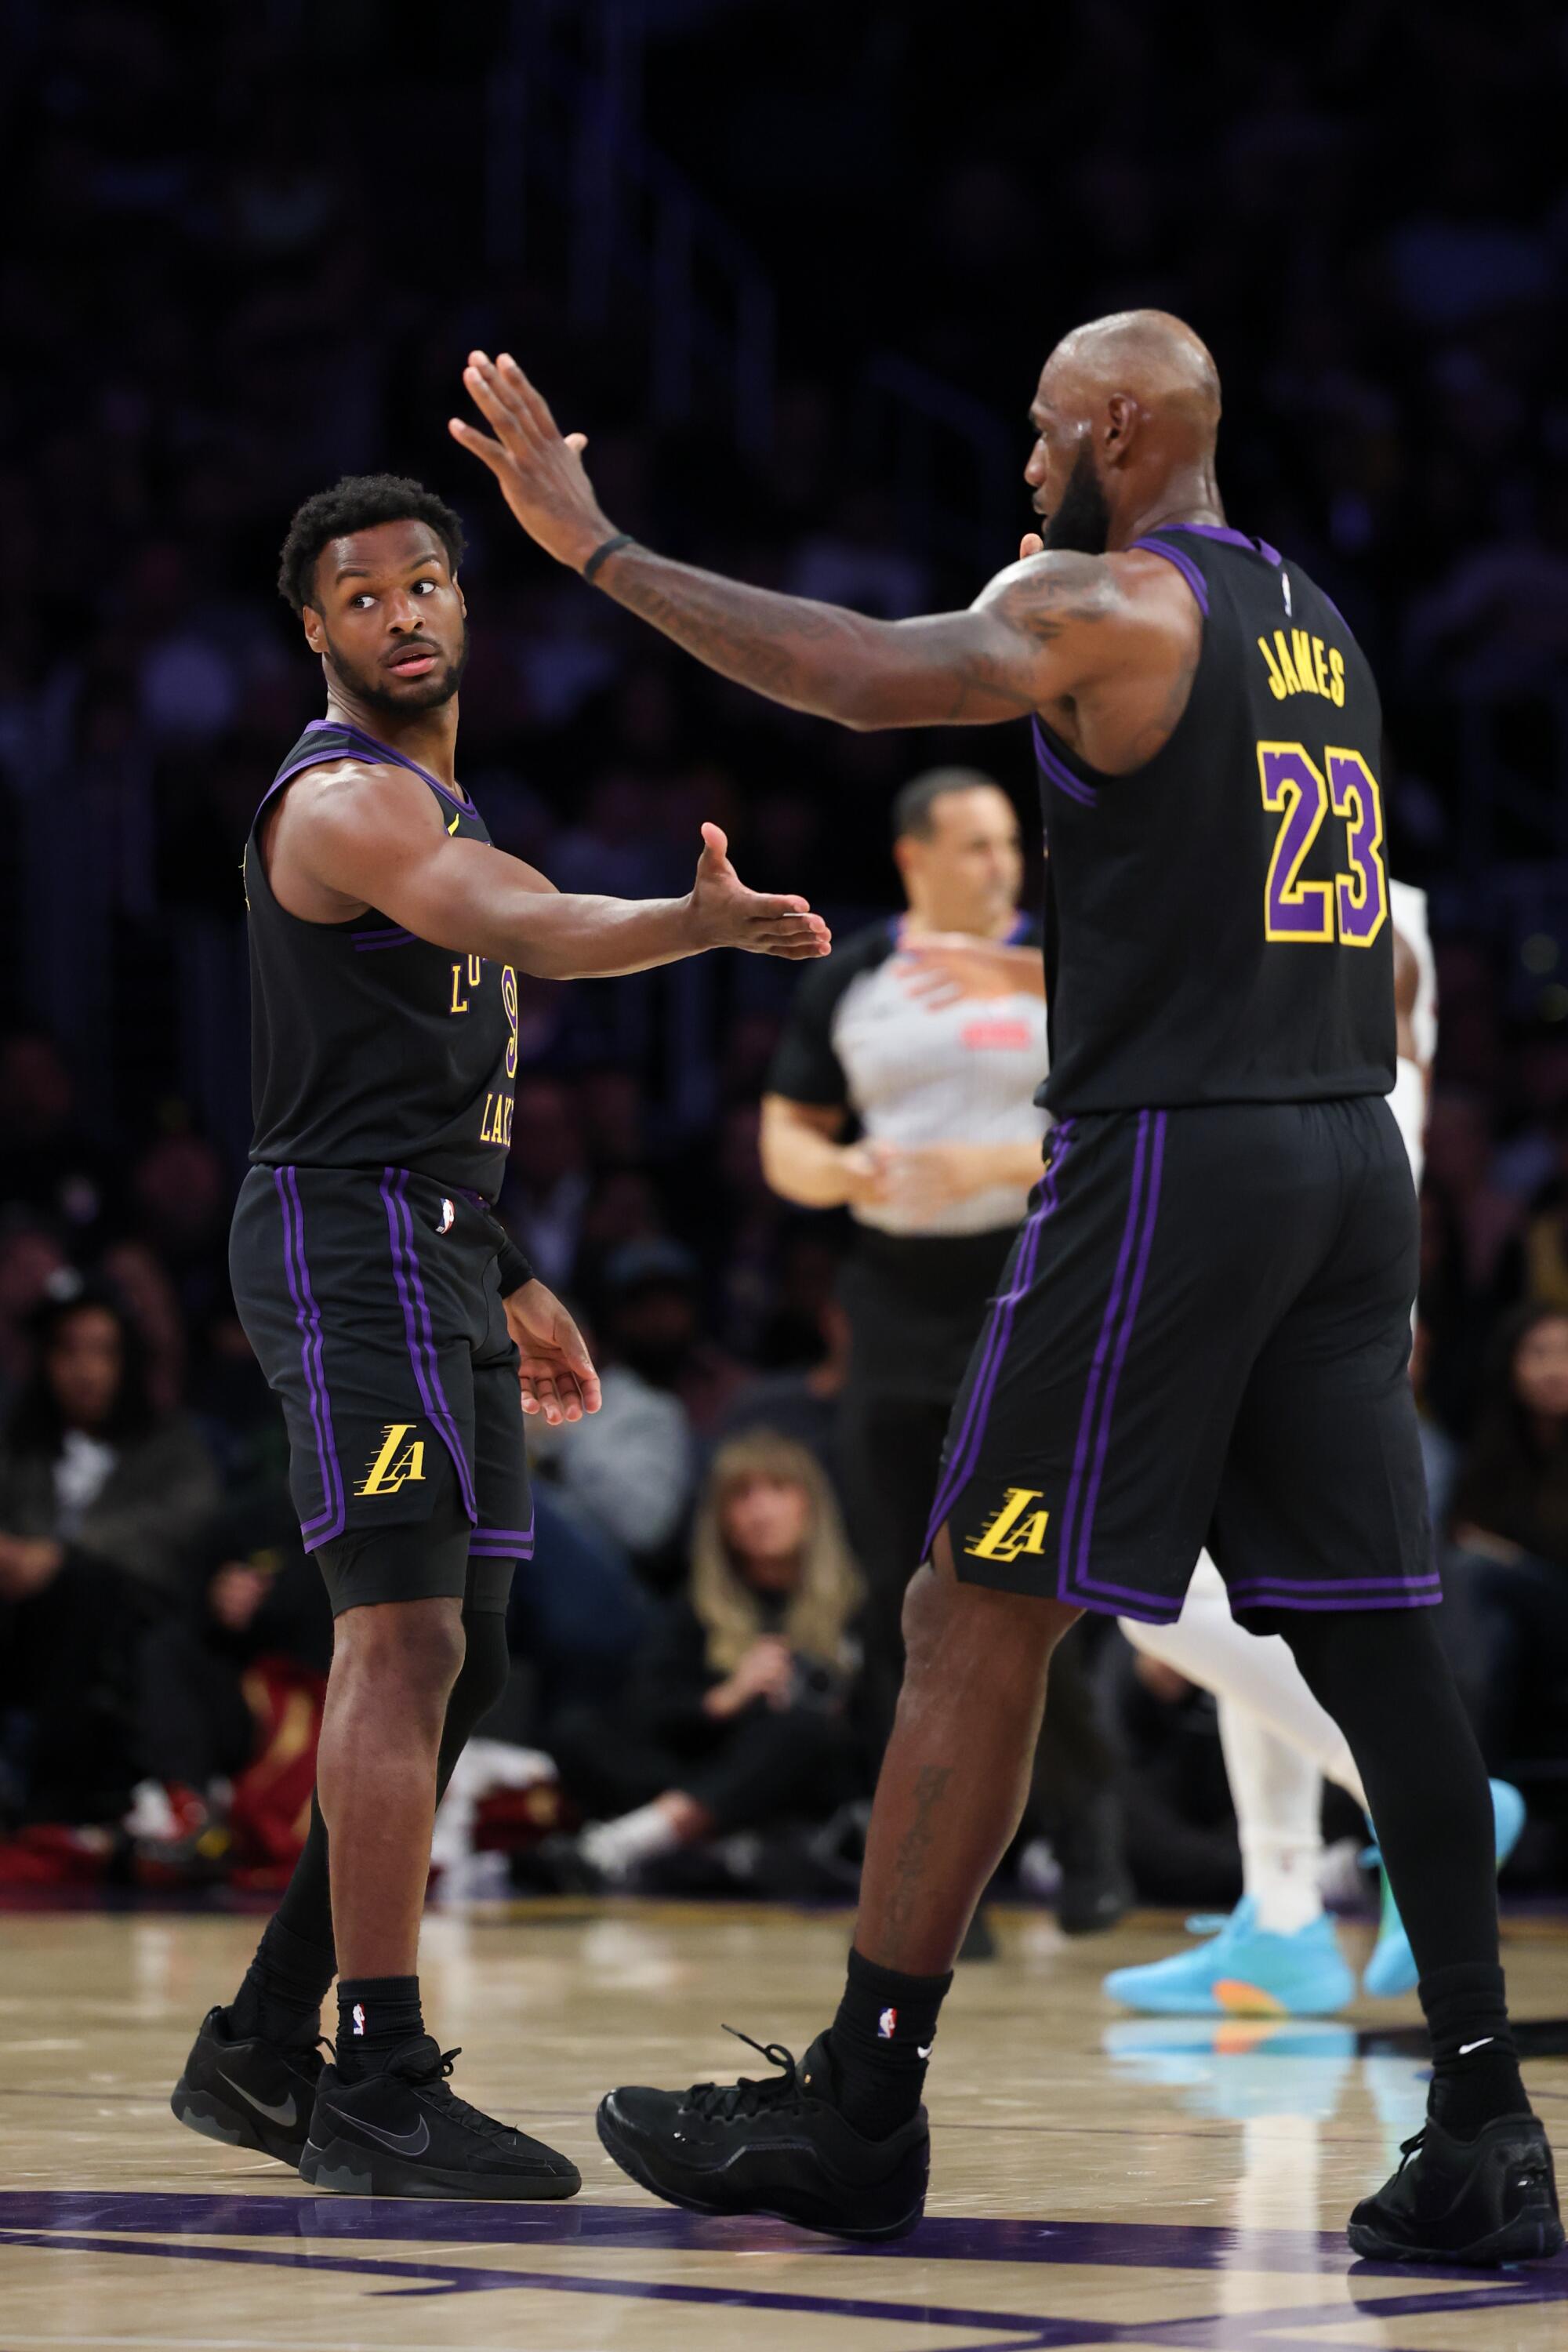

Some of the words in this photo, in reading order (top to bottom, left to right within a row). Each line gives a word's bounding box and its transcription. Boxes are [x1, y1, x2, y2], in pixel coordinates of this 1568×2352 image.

[1256, 626, 1345, 708] JAMES
[1256, 740, 1388, 949] 23
[501, 964, 518, 1079] 9
[479, 1093, 514, 1147] LAK
[353, 1424, 426, 1497] LA
[963, 1487, 1050, 1563] LA
